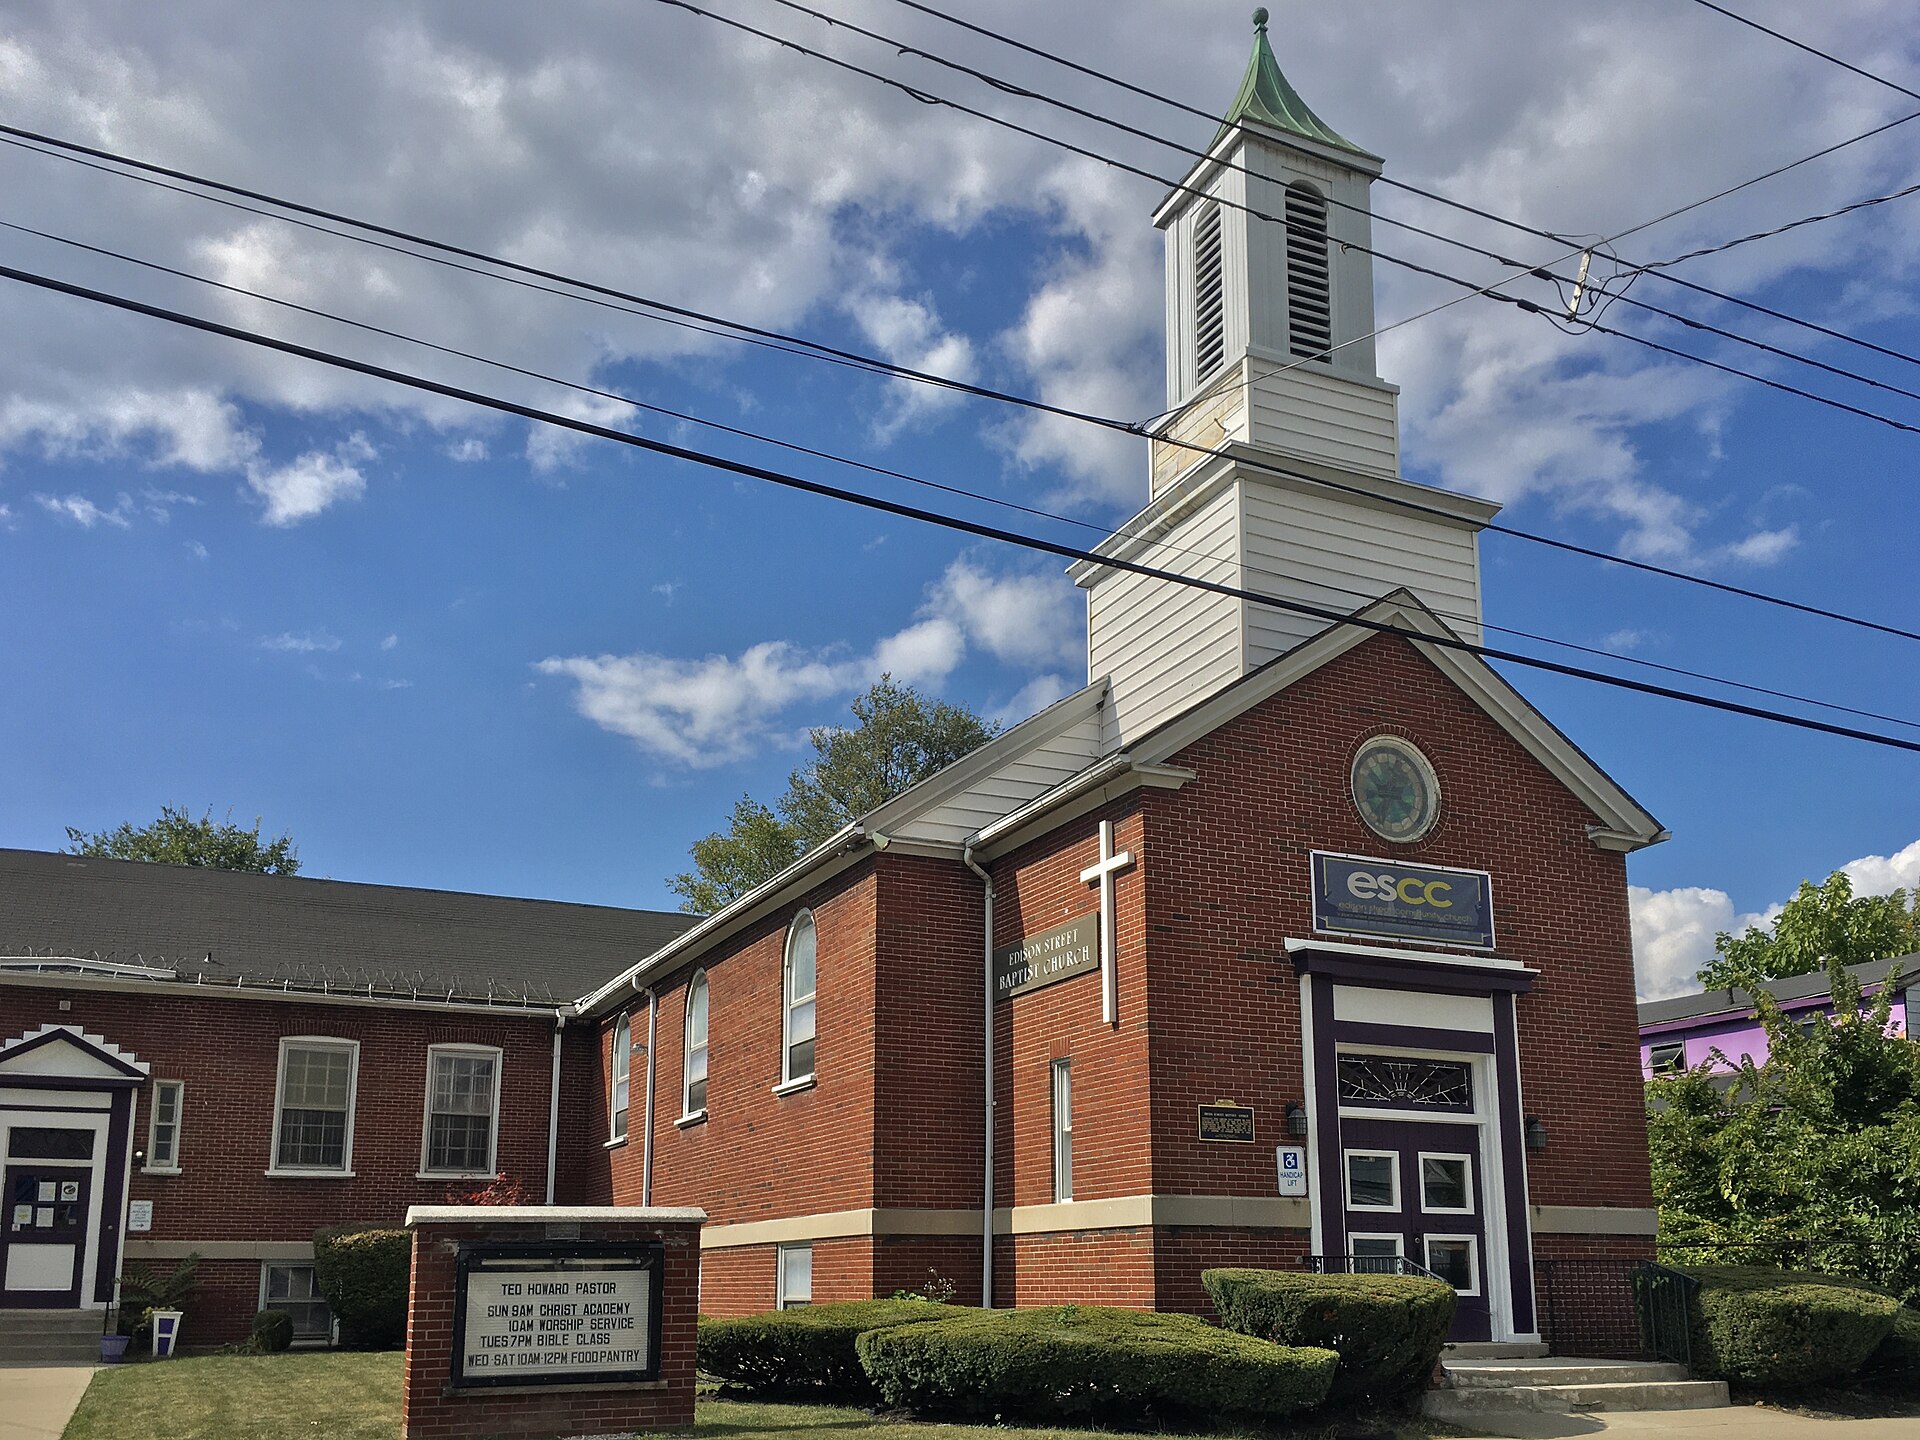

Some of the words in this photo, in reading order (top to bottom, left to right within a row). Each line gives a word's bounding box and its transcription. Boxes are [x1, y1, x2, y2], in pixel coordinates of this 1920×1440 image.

[1347, 871, 1453, 908] escc
[1009, 942, 1041, 966] EDISON
[1044, 928, 1078, 953] STREET
[999, 963, 1040, 990] BAPTIST
[1043, 945, 1090, 975] CHURCH
[502, 1283, 522, 1296] TED
[528, 1282, 569, 1295] HOWARD
[575, 1282, 617, 1294] PASTOR
[488, 1305, 509, 1317] SUN
[512, 1304, 534, 1317] 9AM
[539, 1303, 579, 1316] CHRIST
[583, 1302, 631, 1315] ACADEMY
[508, 1320, 534, 1332] 10AM
[539, 1319, 584, 1331] WORSHIP
[590, 1318, 634, 1330] SERVICE
[481, 1335, 509, 1348] TUES
[510, 1335, 532, 1347] 7PM
[537, 1334, 570, 1346] BIBLE
[576, 1333, 611, 1345] CLASS
[571, 1351, 599, 1364] FOOD
[600, 1350, 640, 1363] PANTRY
